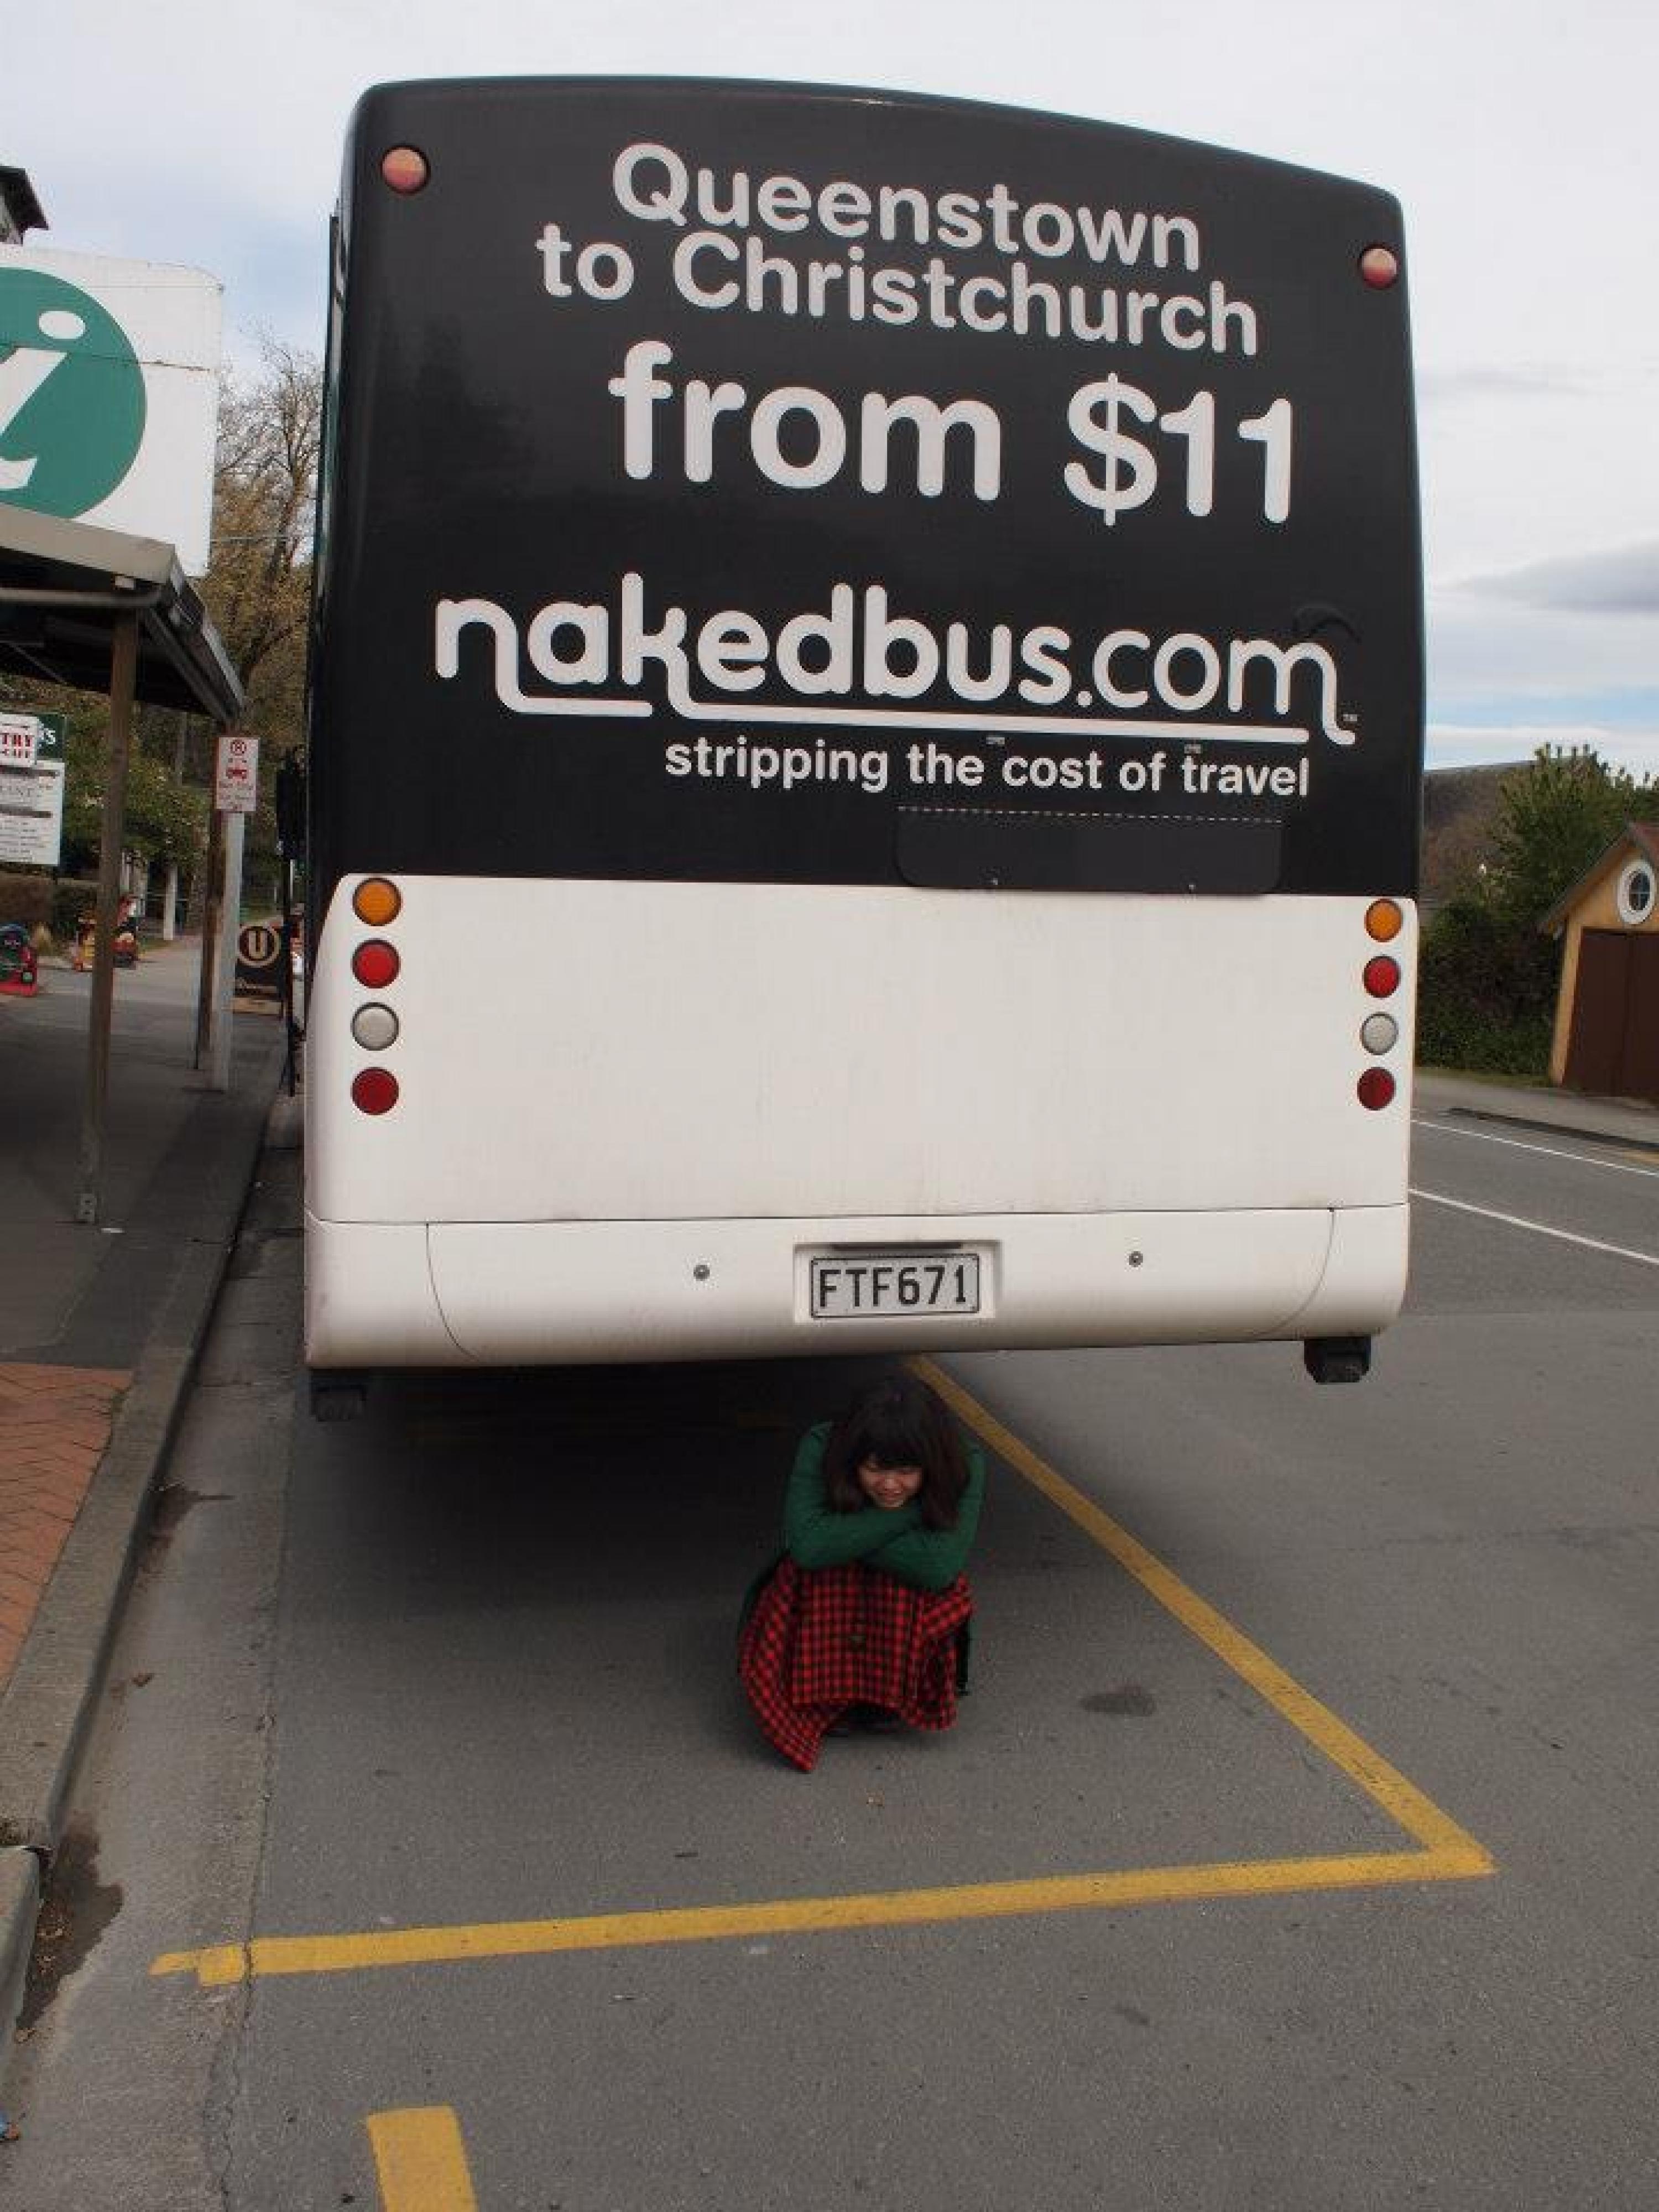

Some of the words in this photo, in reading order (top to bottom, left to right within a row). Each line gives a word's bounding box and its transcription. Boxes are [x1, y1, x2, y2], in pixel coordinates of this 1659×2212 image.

[612, 142, 1199, 272] Queenstown
[534, 223, 634, 300] to
[672, 230, 1256, 356] Christchurch
[608, 340, 1001, 500] from
[1063, 373, 1293, 526] $11
[435, 573, 1355, 745] nakedbus.com
[665, 734, 888, 793] stripping
[907, 742, 984, 786] the
[1002, 750, 1102, 789] cost
[1119, 751, 1166, 791] of
[1181, 755, 1310, 796] travel
[248, 930, 268, 959] U
[820, 1264, 967, 1307] FTF671
